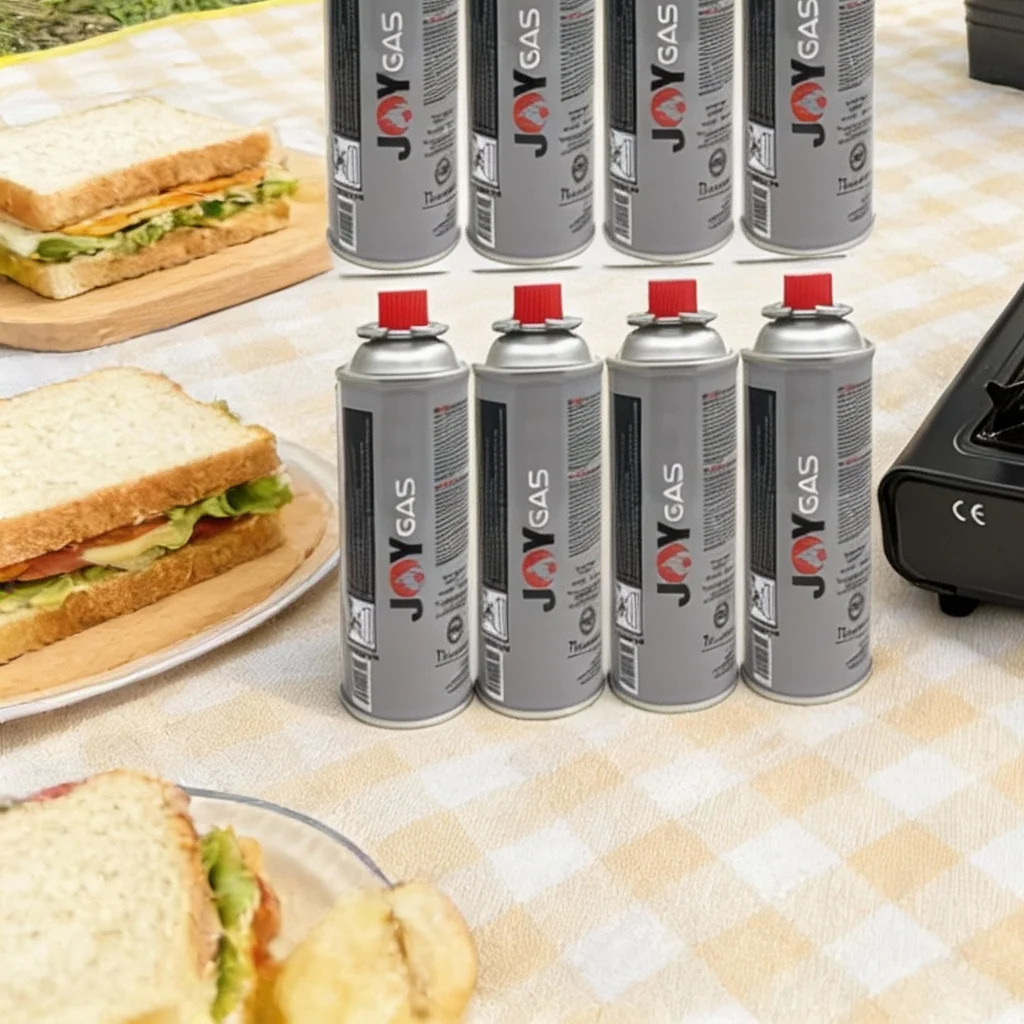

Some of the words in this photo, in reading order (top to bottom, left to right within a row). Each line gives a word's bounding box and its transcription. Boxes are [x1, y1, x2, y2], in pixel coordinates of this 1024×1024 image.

[381, 11, 404, 72] GAS
[519, 8, 541, 69] GAS
[657, 4, 678, 64] GAS
[376, 72, 412, 161] JOY
[513, 68, 548, 157] JOY
[651, 64, 686, 153] JOY
[791, 58, 827, 147] JOY
[395, 477, 416, 536] GAS
[528, 469, 549, 527] GAS
[663, 463, 684, 522] GAS
[798, 455, 819, 514] GAS
[389, 537, 425, 621] JOY
[522, 527, 557, 612] JOY
[657, 522, 692, 606] JOY
[791, 513, 826, 598] JOY
